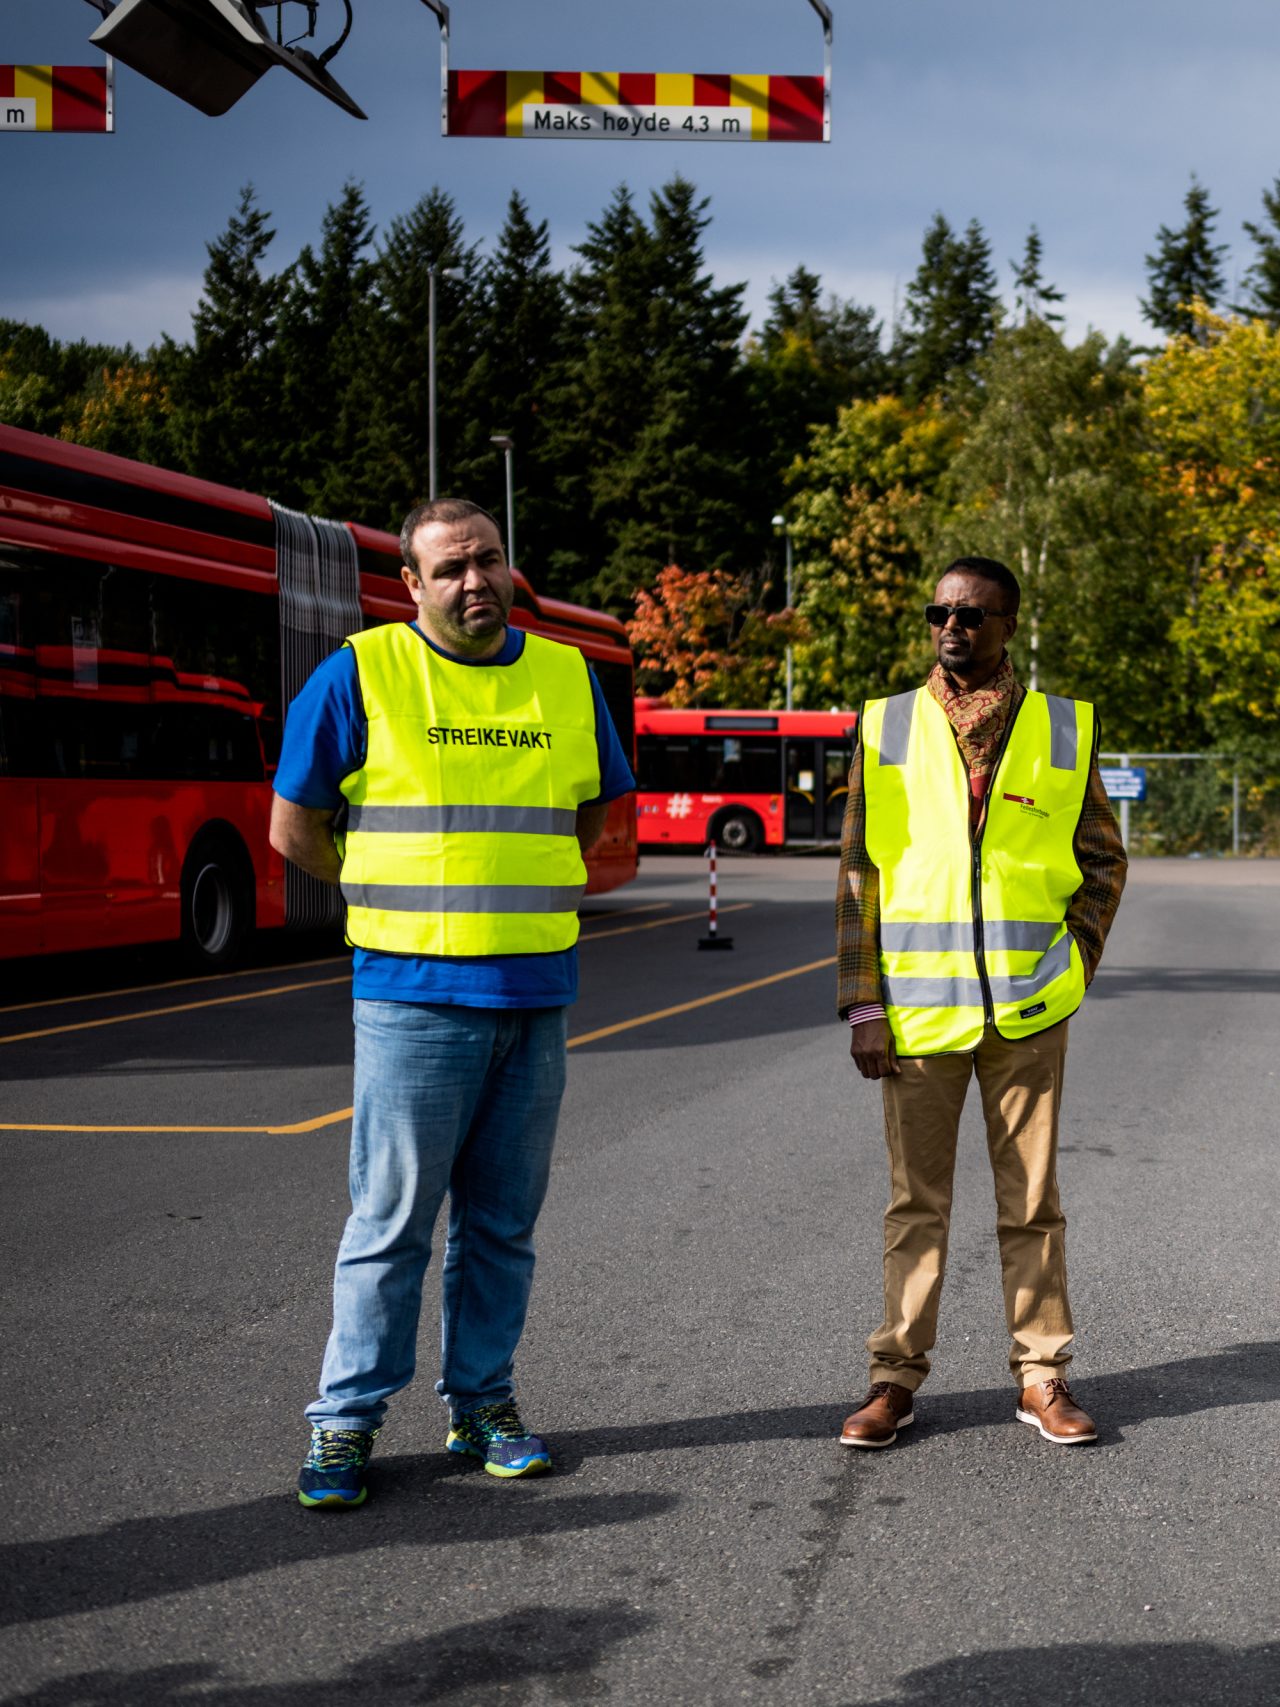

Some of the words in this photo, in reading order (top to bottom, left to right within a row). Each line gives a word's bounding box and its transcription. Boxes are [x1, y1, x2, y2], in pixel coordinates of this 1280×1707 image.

[6, 108, 25, 123] m
[533, 110, 592, 131] Maks
[602, 112, 671, 136] høyde
[721, 117, 741, 133] m
[427, 726, 552, 750] STREIKEVAKT
